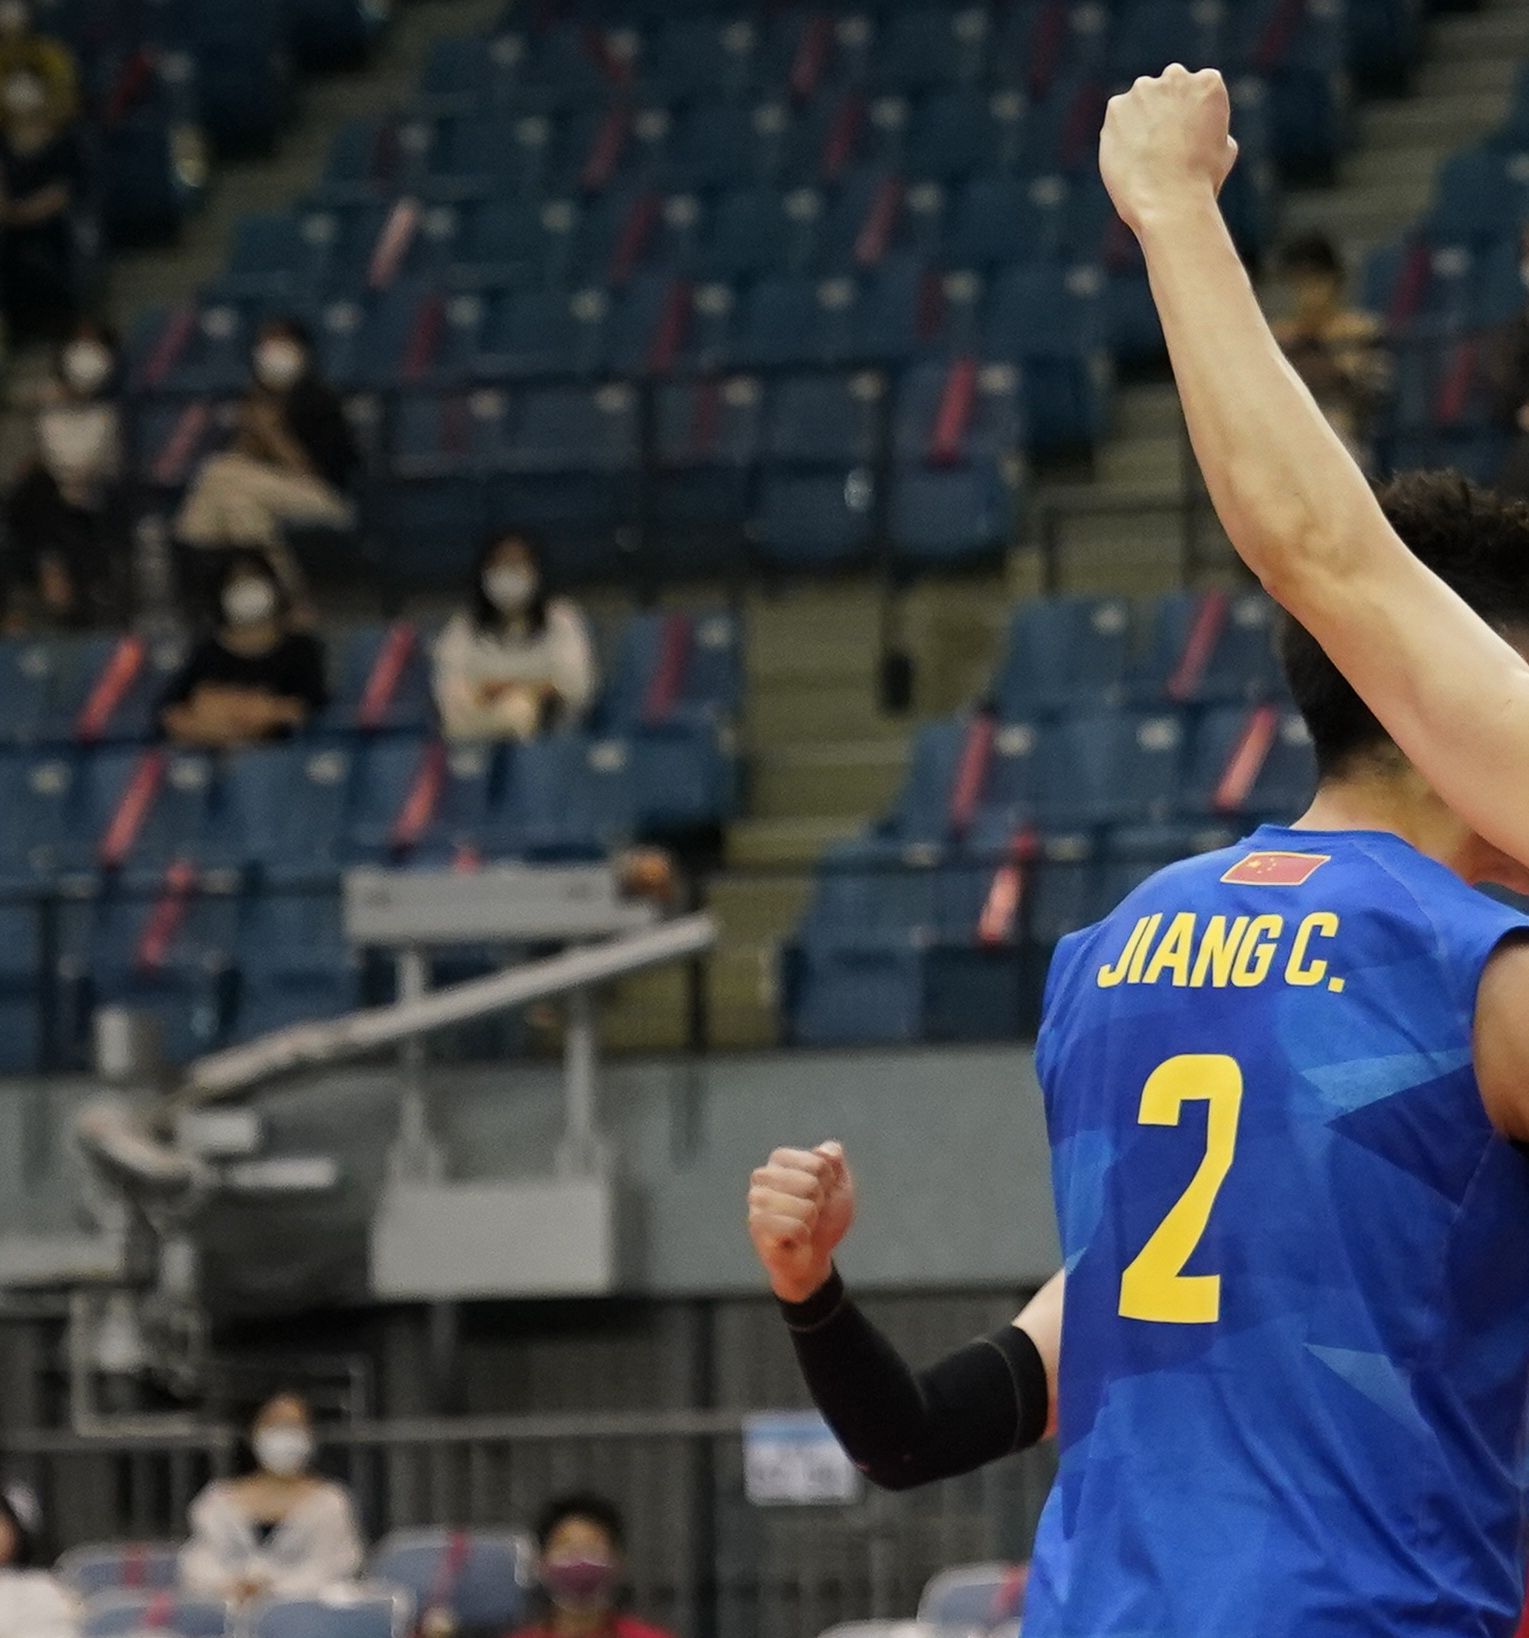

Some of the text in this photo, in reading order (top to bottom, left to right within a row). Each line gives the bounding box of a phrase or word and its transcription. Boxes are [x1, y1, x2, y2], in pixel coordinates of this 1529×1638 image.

[1096, 911, 1346, 994] JIANG C.
[1118, 1053, 1243, 1324] 2
